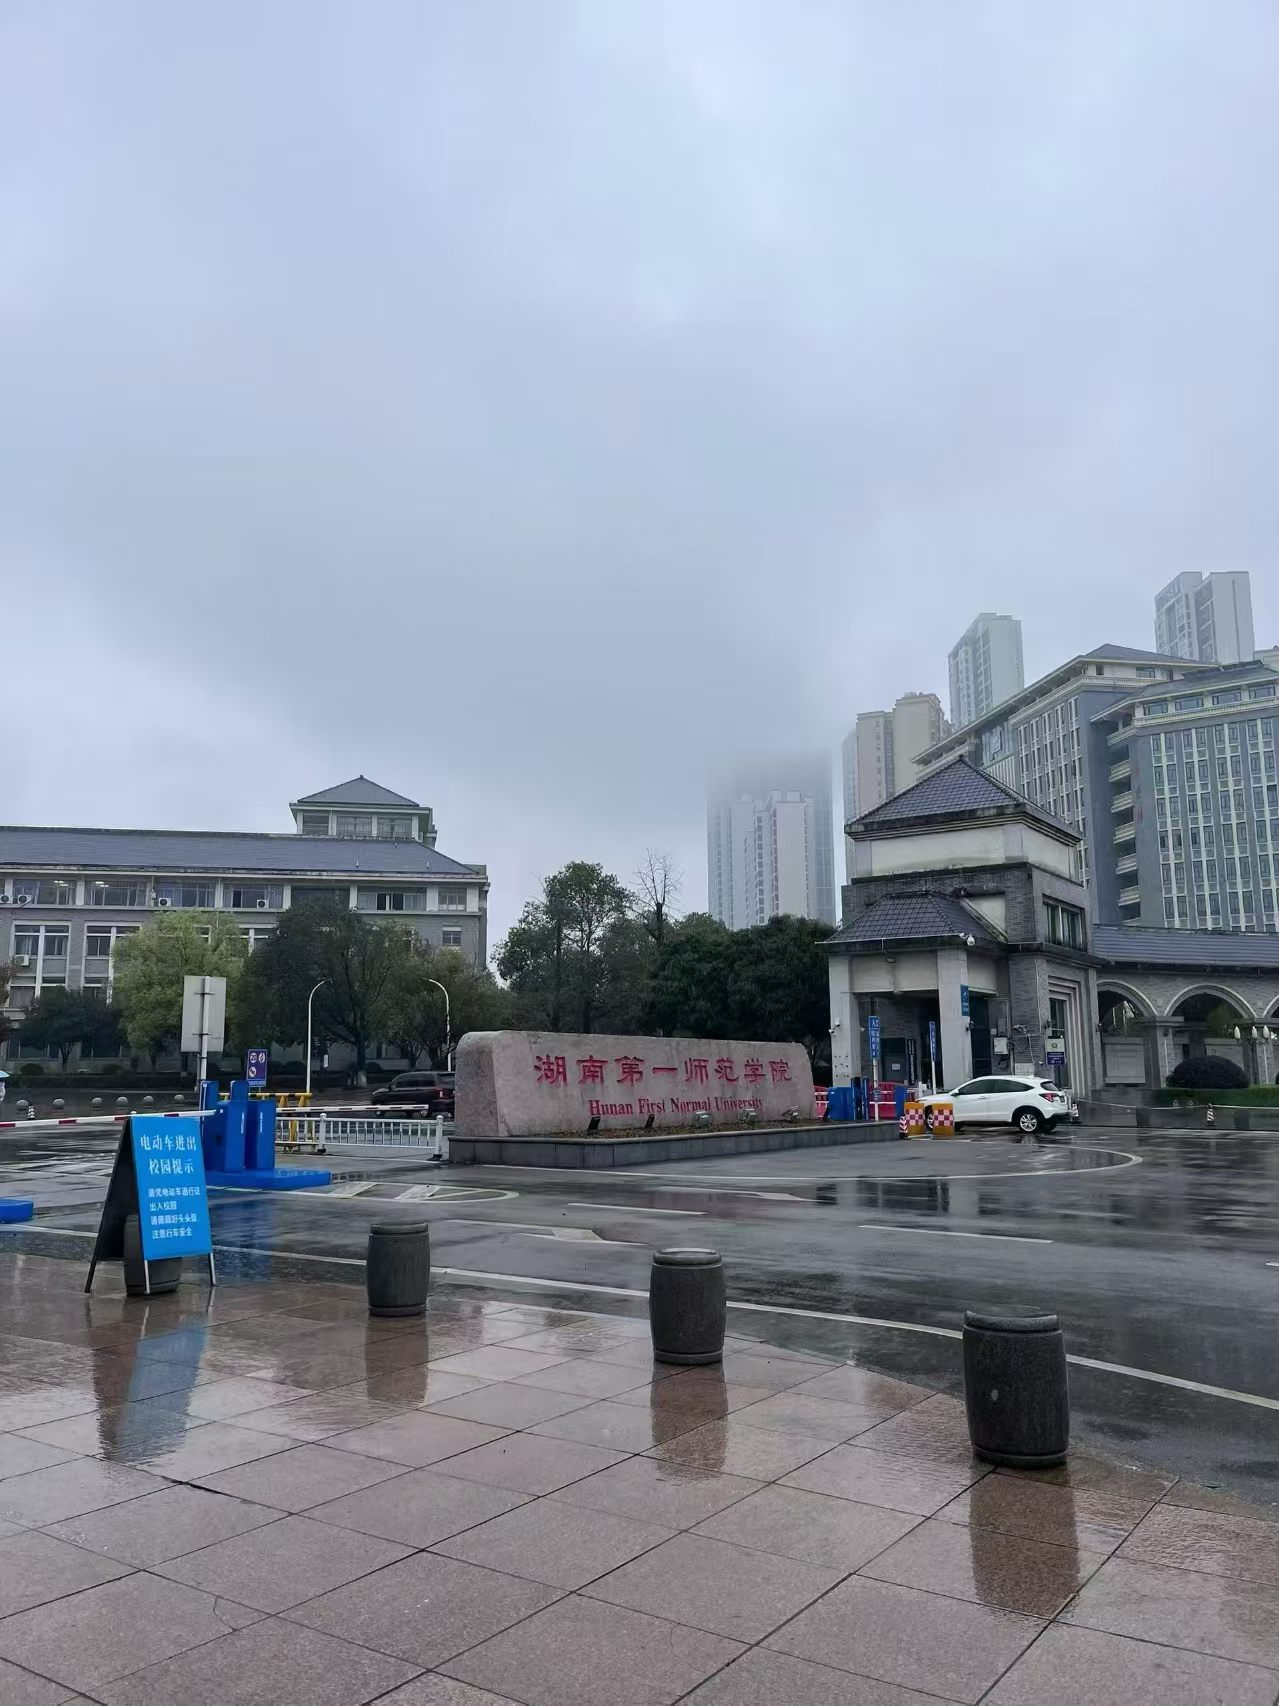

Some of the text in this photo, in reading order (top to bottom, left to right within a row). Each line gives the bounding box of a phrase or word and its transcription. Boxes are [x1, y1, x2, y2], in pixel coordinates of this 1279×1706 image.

[533, 1054, 793, 1086] 湖南第一师范学院
[589, 1096, 764, 1116] Hunan First Normal University
[140, 1134, 197, 1151] 电动车进出
[149, 1158, 194, 1175] 校园提示
